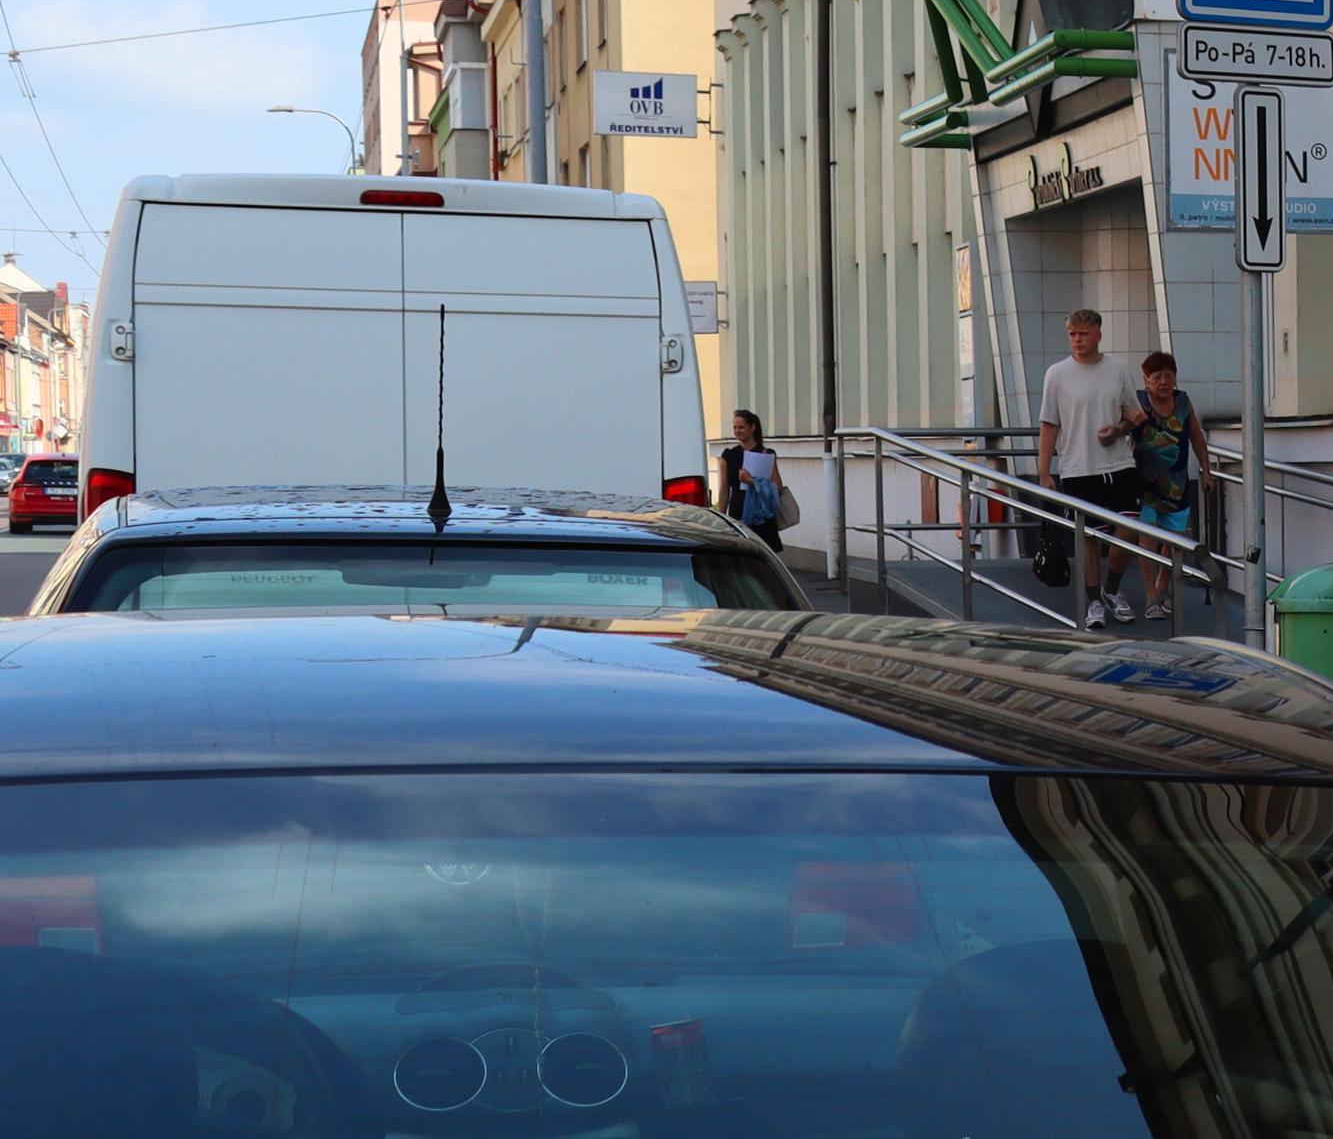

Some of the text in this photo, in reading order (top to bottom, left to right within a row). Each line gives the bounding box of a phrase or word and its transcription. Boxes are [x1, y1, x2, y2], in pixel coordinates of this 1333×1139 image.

[1195, 40, 1255, 64] Po-Pá
[630, 100, 664, 115] OVB
[609, 122, 684, 135] ŘEDITELSTVÍ
[1285, 202, 1317, 214] UDIO
[230, 573, 648, 586] PEUGEOT BOXER
